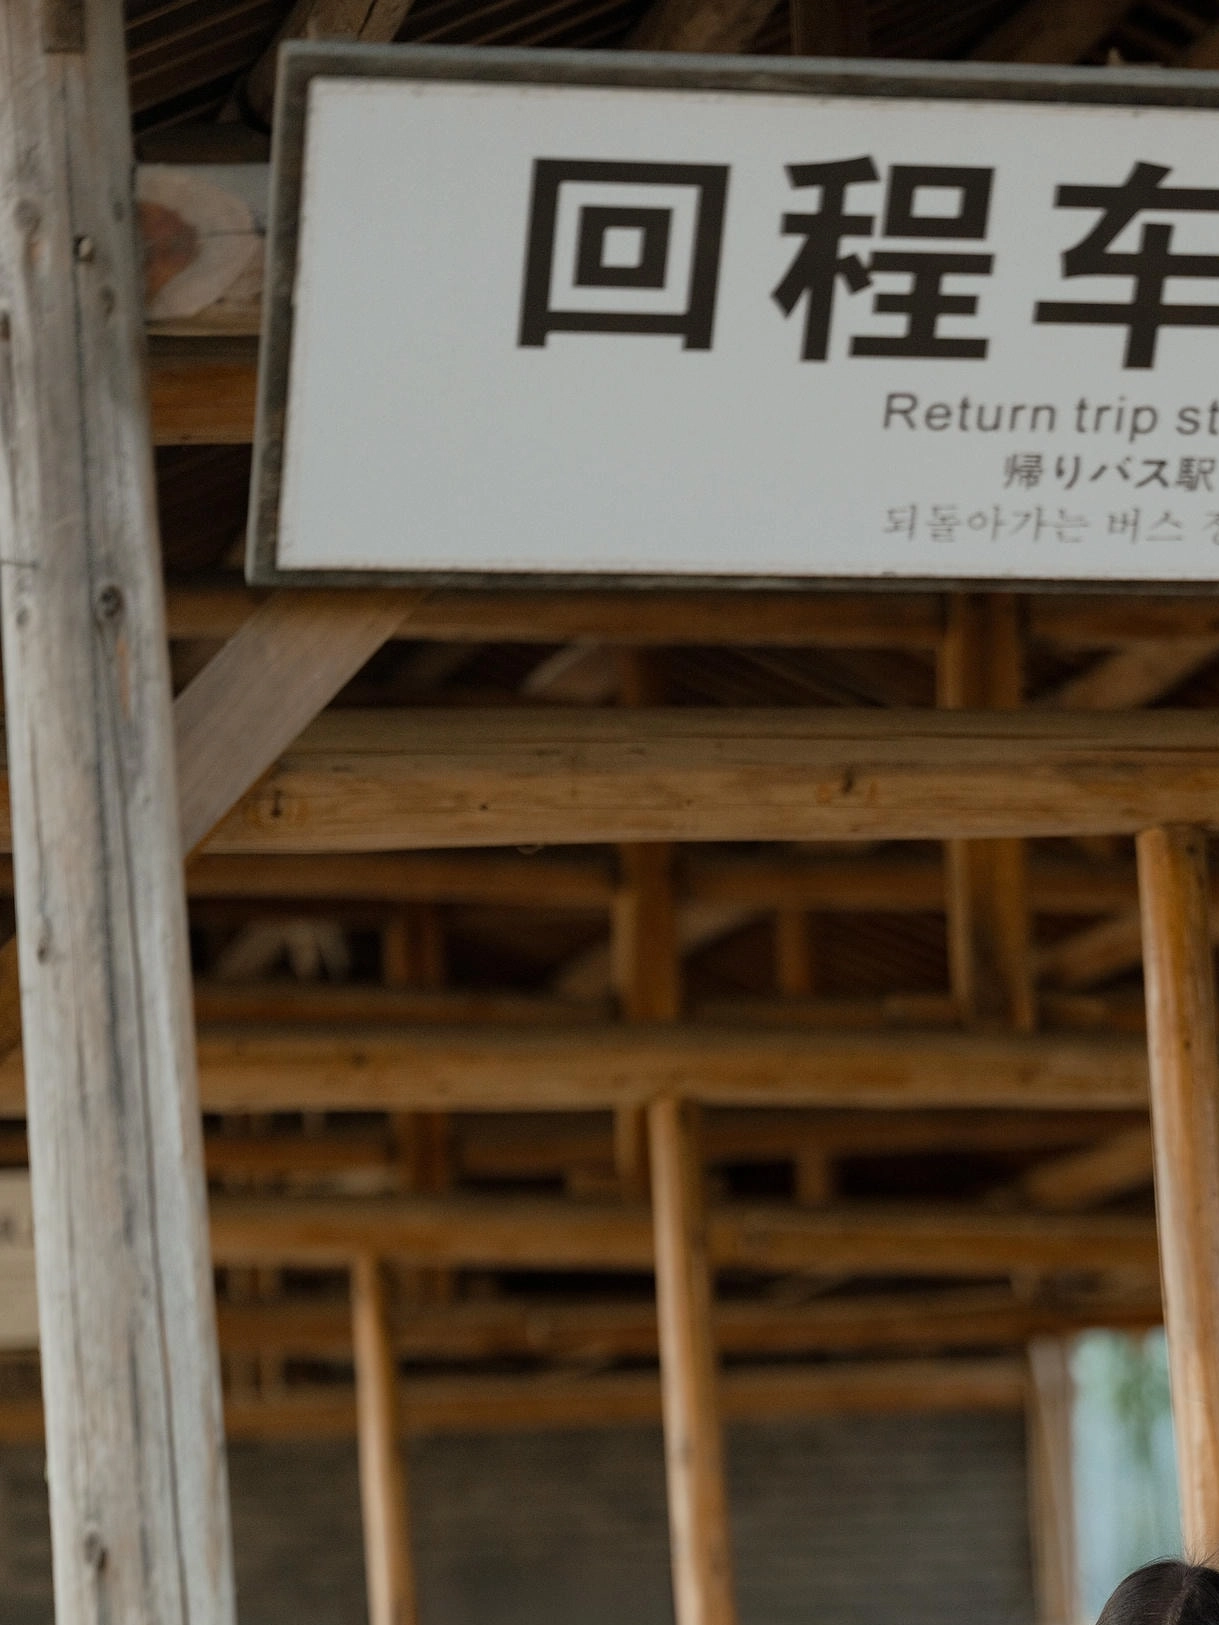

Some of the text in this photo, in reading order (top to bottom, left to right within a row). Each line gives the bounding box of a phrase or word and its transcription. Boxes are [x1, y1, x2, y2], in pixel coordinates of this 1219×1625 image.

[882, 390, 1057, 433] Return
[1075, 396, 1159, 444] trip
[1004, 452, 1218, 492] 帰りバス駅
[883, 502, 1090, 544] 되돌아가는
[1106, 506, 1184, 545] 버스
